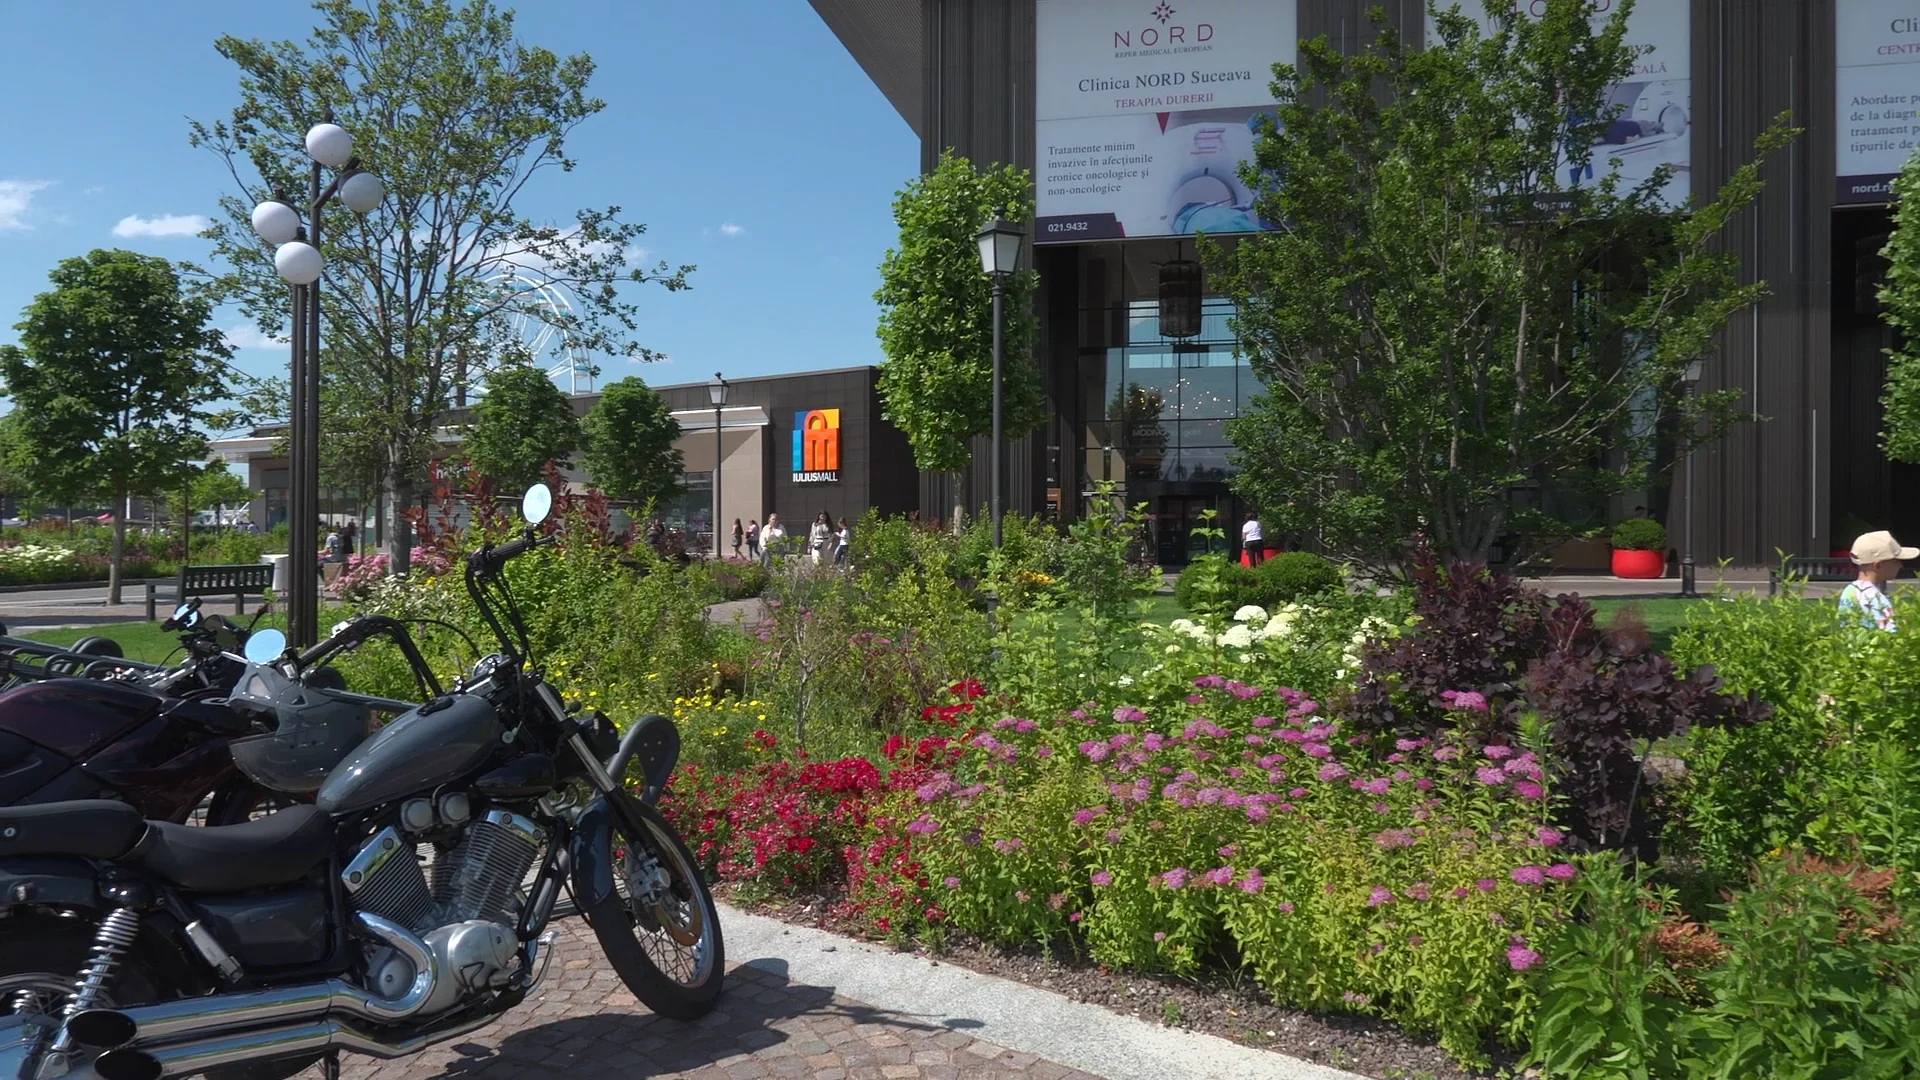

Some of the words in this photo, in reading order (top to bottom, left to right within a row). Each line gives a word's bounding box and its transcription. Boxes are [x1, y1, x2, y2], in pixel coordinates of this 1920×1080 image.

[1114, 23, 1213, 48] NORD
[1115, 50, 1138, 58] REPER
[1139, 47, 1172, 57] MEDICAL
[1173, 44, 1212, 54] EUROPEAN
[1078, 76, 1130, 92] Clinica
[1135, 72, 1185, 88] NORD
[1191, 70, 1251, 84] Suceava
[1114, 96, 1162, 109] TERAPIA
[1166, 92, 1214, 105] DURERII
[1850, 95, 1907, 107] Abordare
[1850, 111, 1864, 121] de
[1869, 110, 1879, 120] la
[1883, 108, 1920, 121] diagn
[1850, 125, 1908, 137] tratament
[1048, 144, 1101, 156] Tratamente
[1104, 142, 1135, 152] minim
[1850, 139, 1895, 154] tipurile
[1898, 138, 1913, 149] de
[1048, 159, 1087, 169] invazive
[1090, 156, 1099, 166] în
[1047, 172, 1083, 182] cronice
[1085, 169, 1138, 181] oncologice
[1047, 182, 1121, 196] non-oncologice
[1047, 221, 1088, 233] 021.9432
